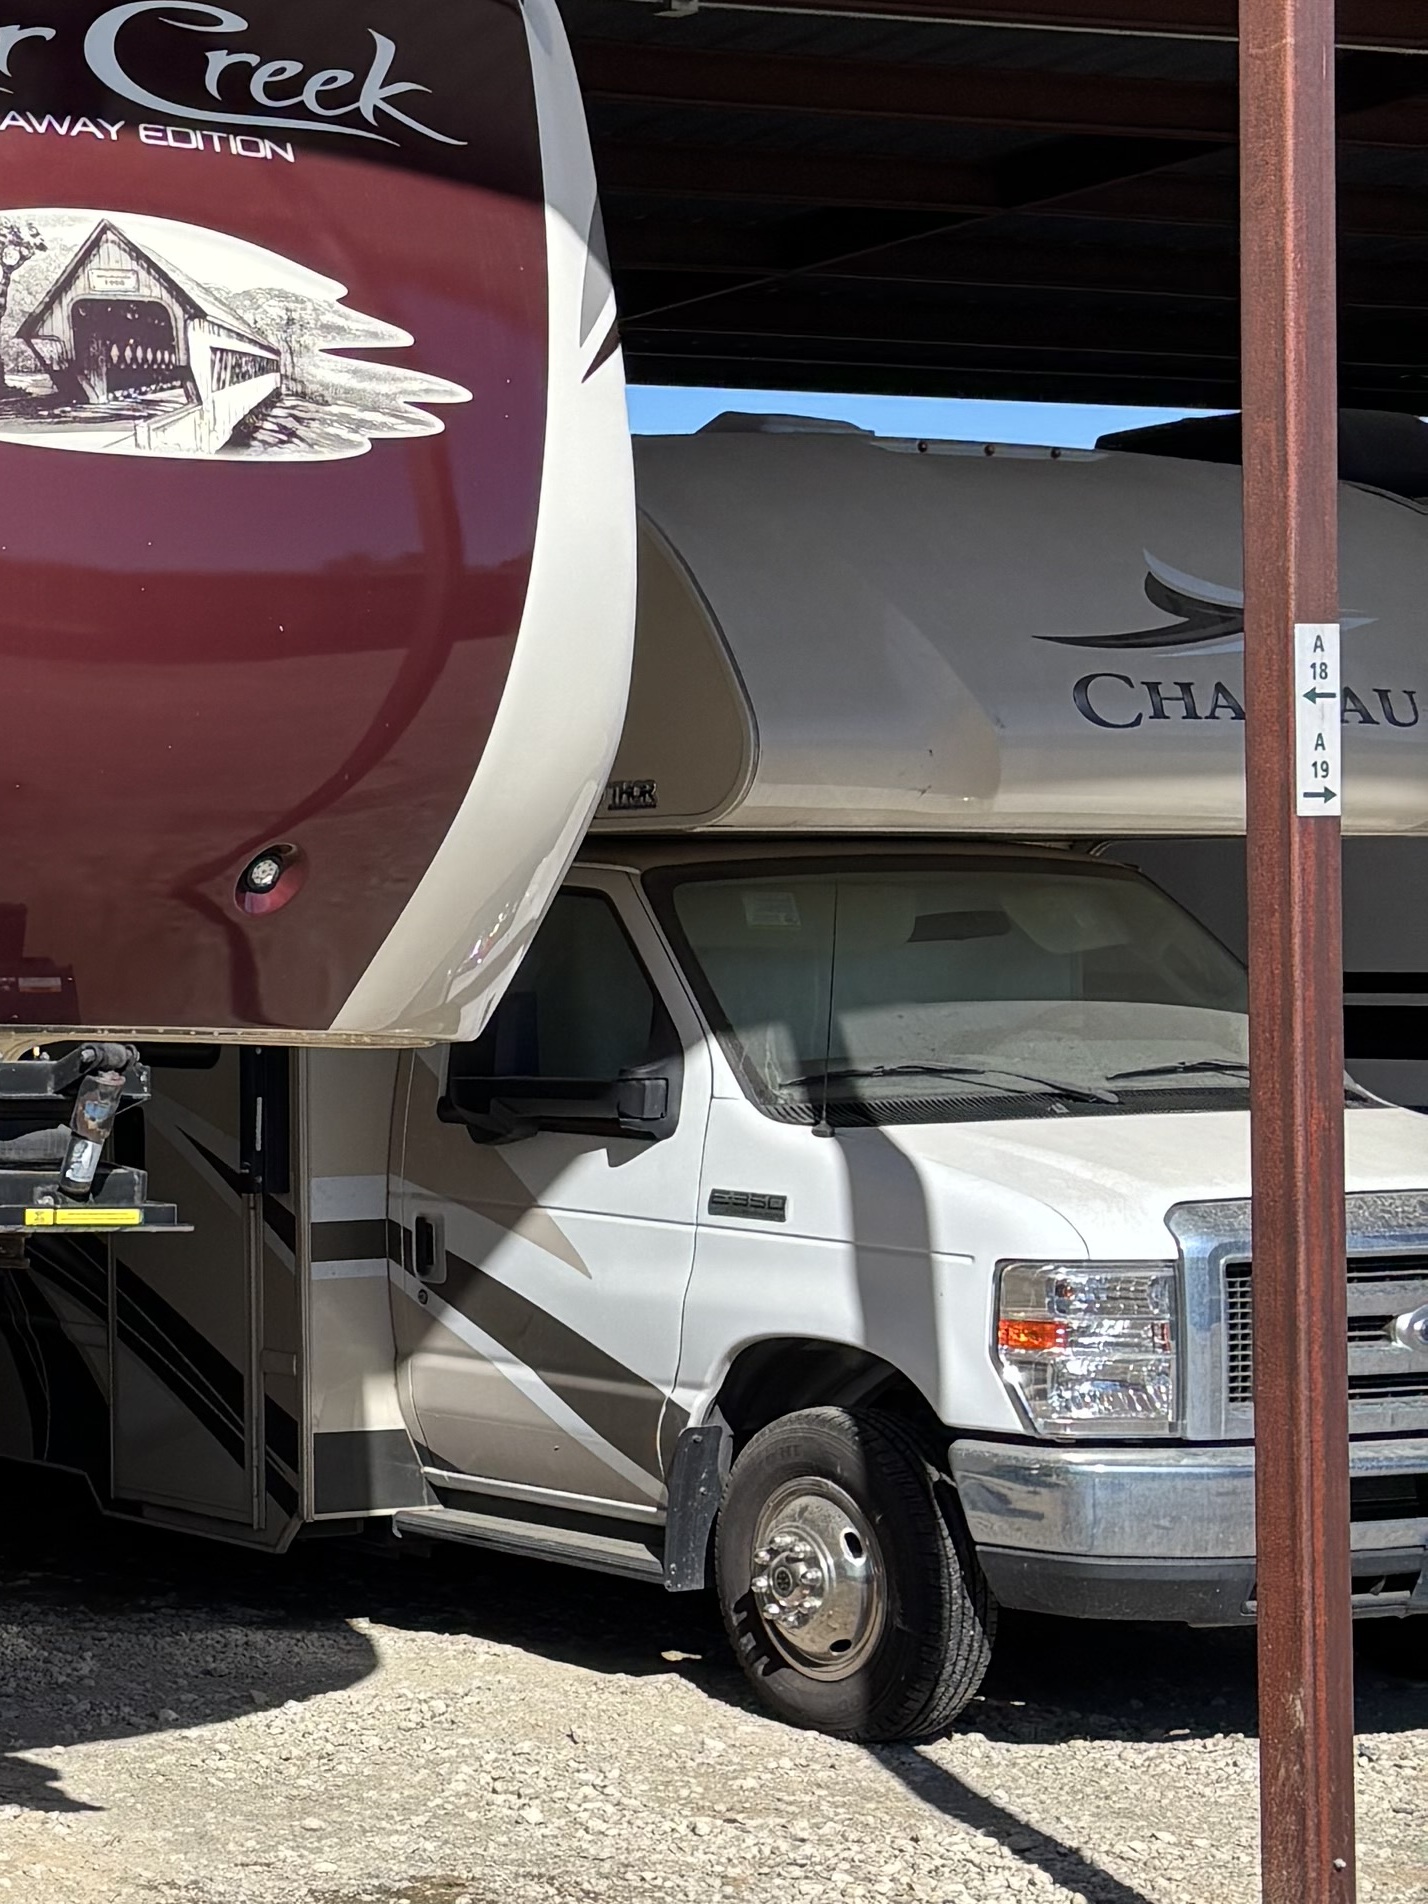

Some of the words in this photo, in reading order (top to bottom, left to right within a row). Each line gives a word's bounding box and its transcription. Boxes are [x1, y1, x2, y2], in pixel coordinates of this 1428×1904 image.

[83, 0, 469, 148] Creek
[138, 123, 296, 164] EDITION
[1312, 634, 1325, 653] A
[1309, 661, 1329, 681] 18
[1072, 672, 1420, 729] CHAAU
[1314, 732, 1326, 751] A
[1311, 760, 1330, 779] 19
